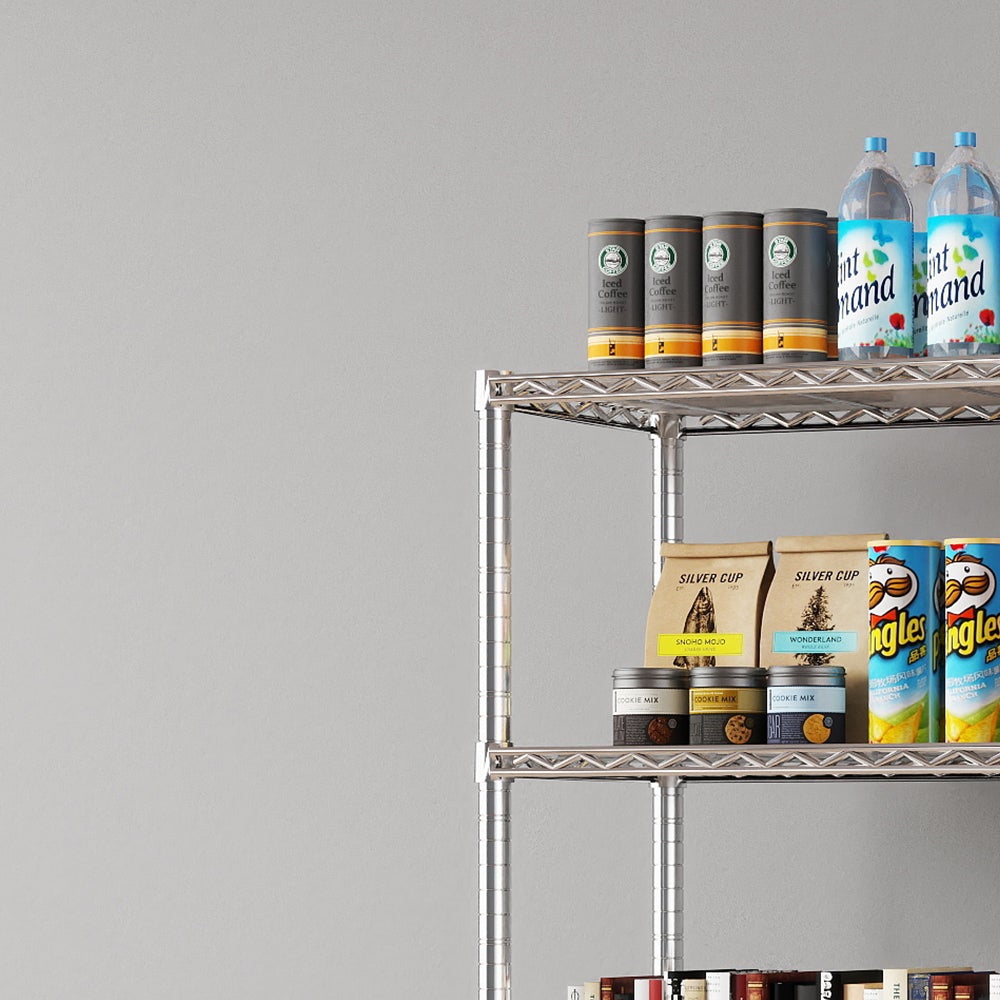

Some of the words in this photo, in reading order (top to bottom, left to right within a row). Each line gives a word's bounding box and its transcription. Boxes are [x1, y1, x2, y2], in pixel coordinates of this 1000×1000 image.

[708, 272, 724, 282] Iced
[772, 270, 791, 280] Iced
[602, 279, 623, 287] Iced
[653, 276, 671, 286] Iced
[769, 281, 797, 291] Coffee
[598, 289, 628, 299] Coffee
[650, 287, 677, 296] Coffee
[705, 284, 730, 294] Coffee
[679, 574, 717, 584] SILVER
[720, 572, 744, 583] CUP
[795, 571, 832, 582] SILVER
[836, 570, 860, 581] CUP
[790, 636, 842, 644] WONDERLAND
[722, 695, 738, 703] MIX
[801, 694, 816, 702] MIX
